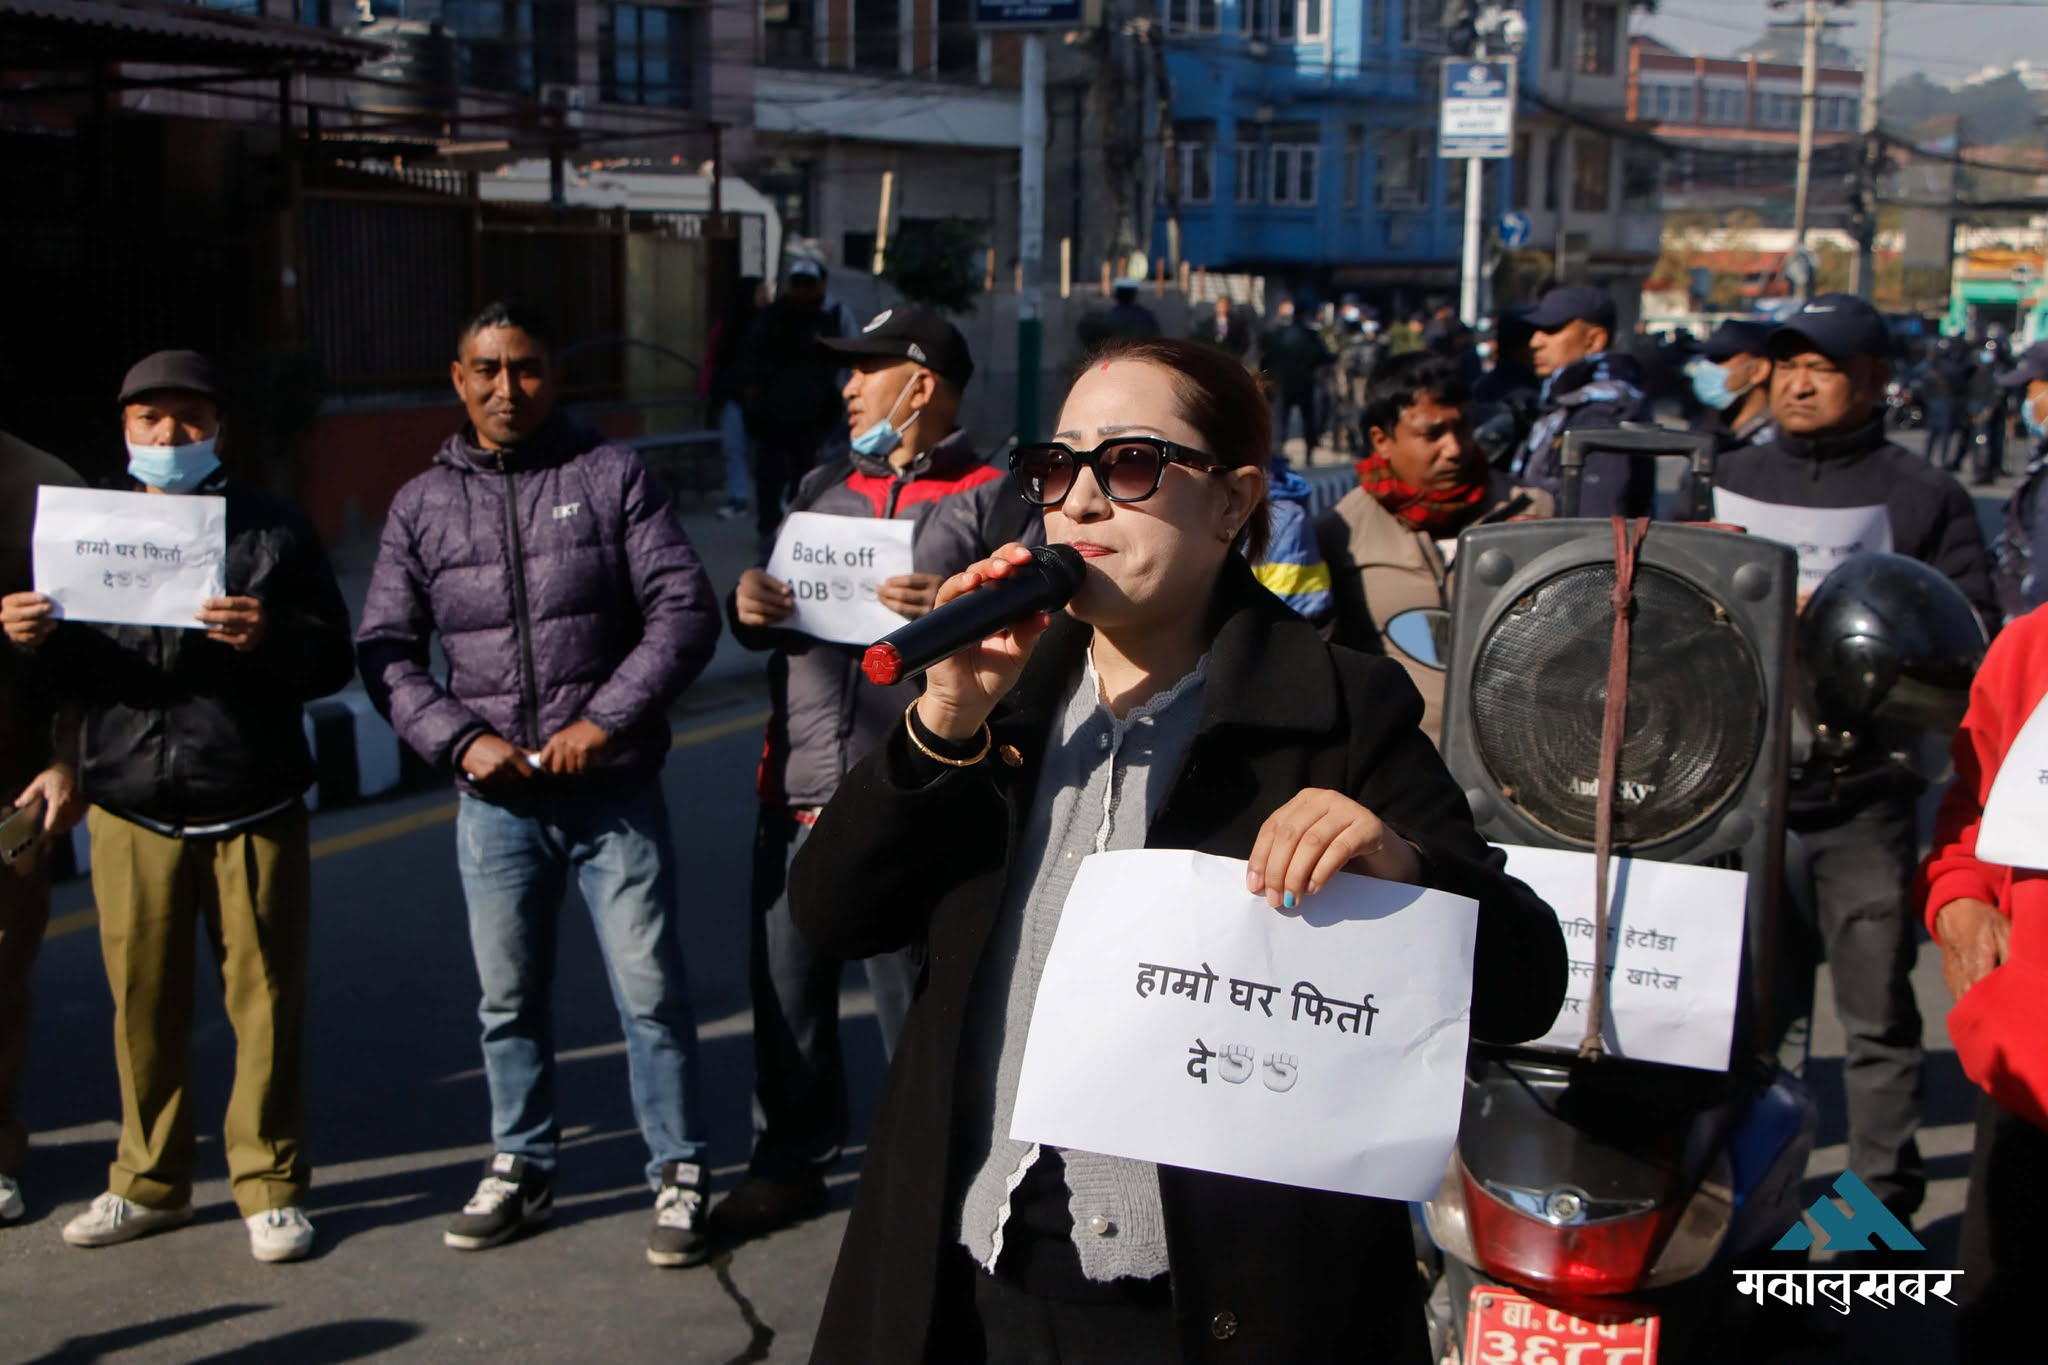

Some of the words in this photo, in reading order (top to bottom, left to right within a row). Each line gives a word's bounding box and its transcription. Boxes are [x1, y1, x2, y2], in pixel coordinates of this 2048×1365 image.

[116, 544, 137, 559] घर
[792, 541, 837, 566] Back
[844, 547, 877, 568] off
[1627, 968, 1682, 992] खारेज
[1135, 961, 1219, 1004] हाम्रो
[1229, 978, 1281, 1018] घर
[1291, 980, 1380, 1036] फिर्ता
[1187, 1038, 1217, 1084] दे
